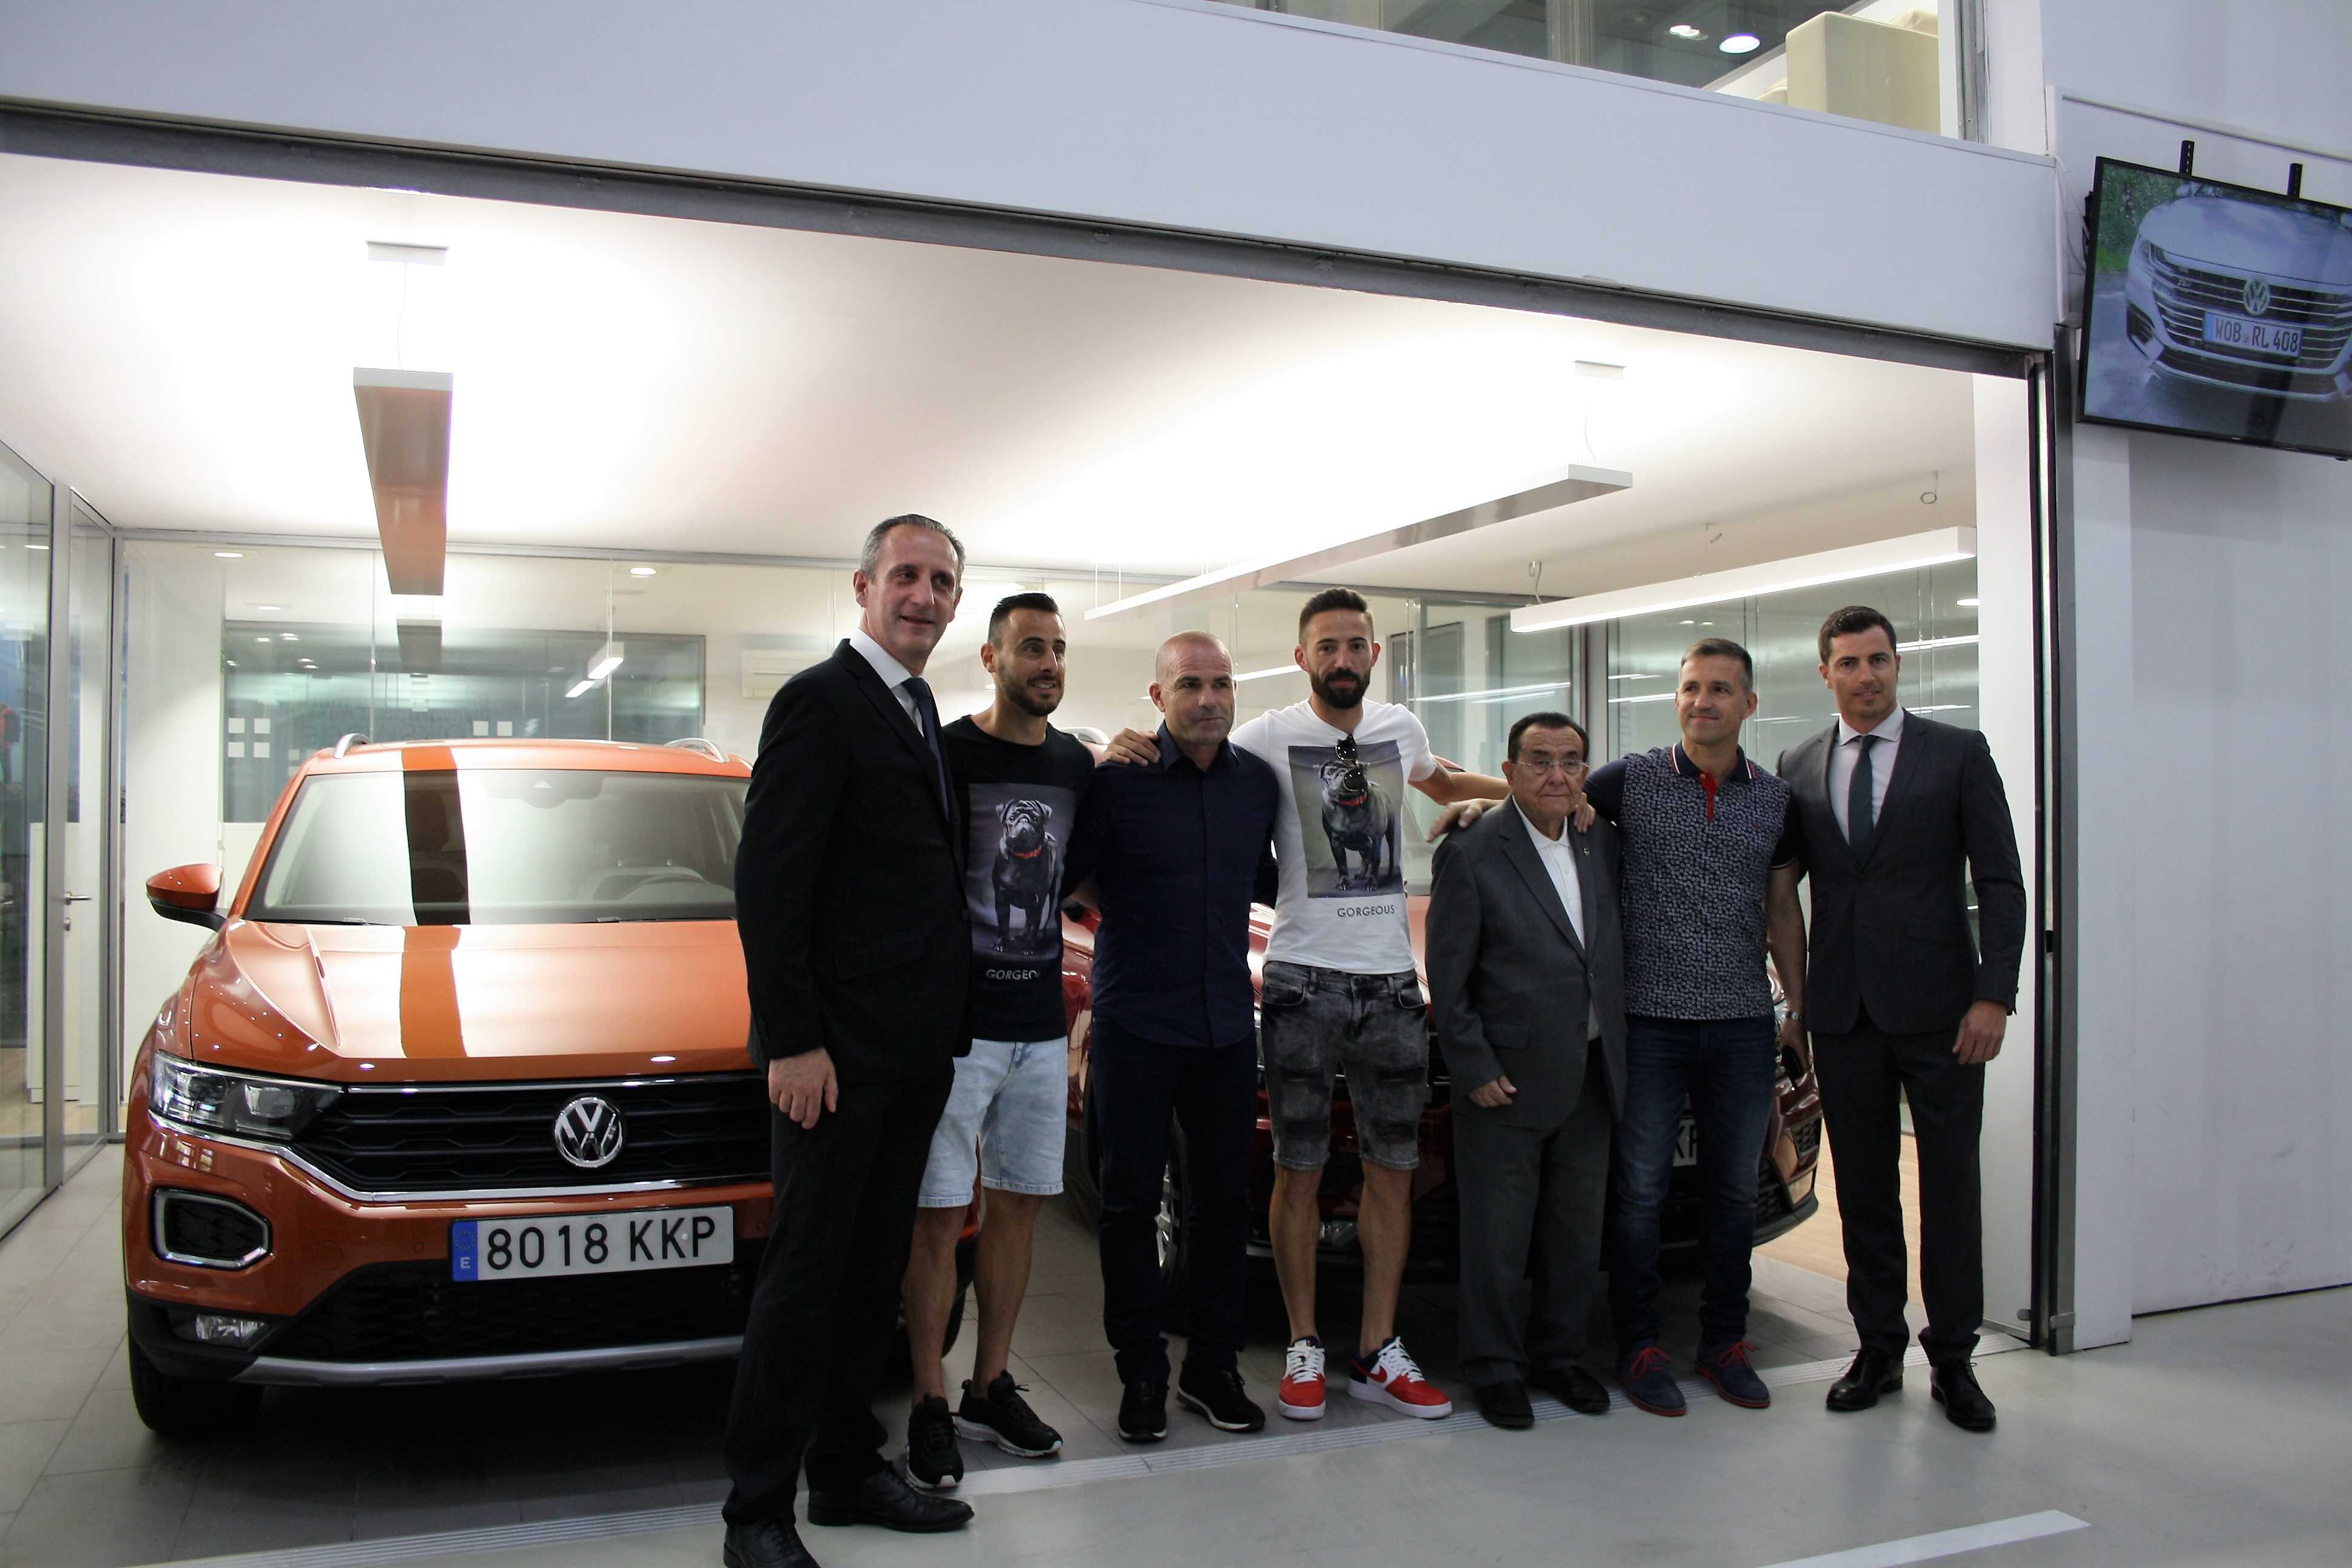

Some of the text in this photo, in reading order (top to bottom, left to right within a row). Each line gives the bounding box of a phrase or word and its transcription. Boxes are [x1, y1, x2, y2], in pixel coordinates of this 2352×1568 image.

[2215, 318, 2299, 352] WOB RL 408
[1337, 905, 1395, 917] GORGEOUS
[487, 1215, 716, 1270] 8018 KKP
[460, 1257, 470, 1269] E
